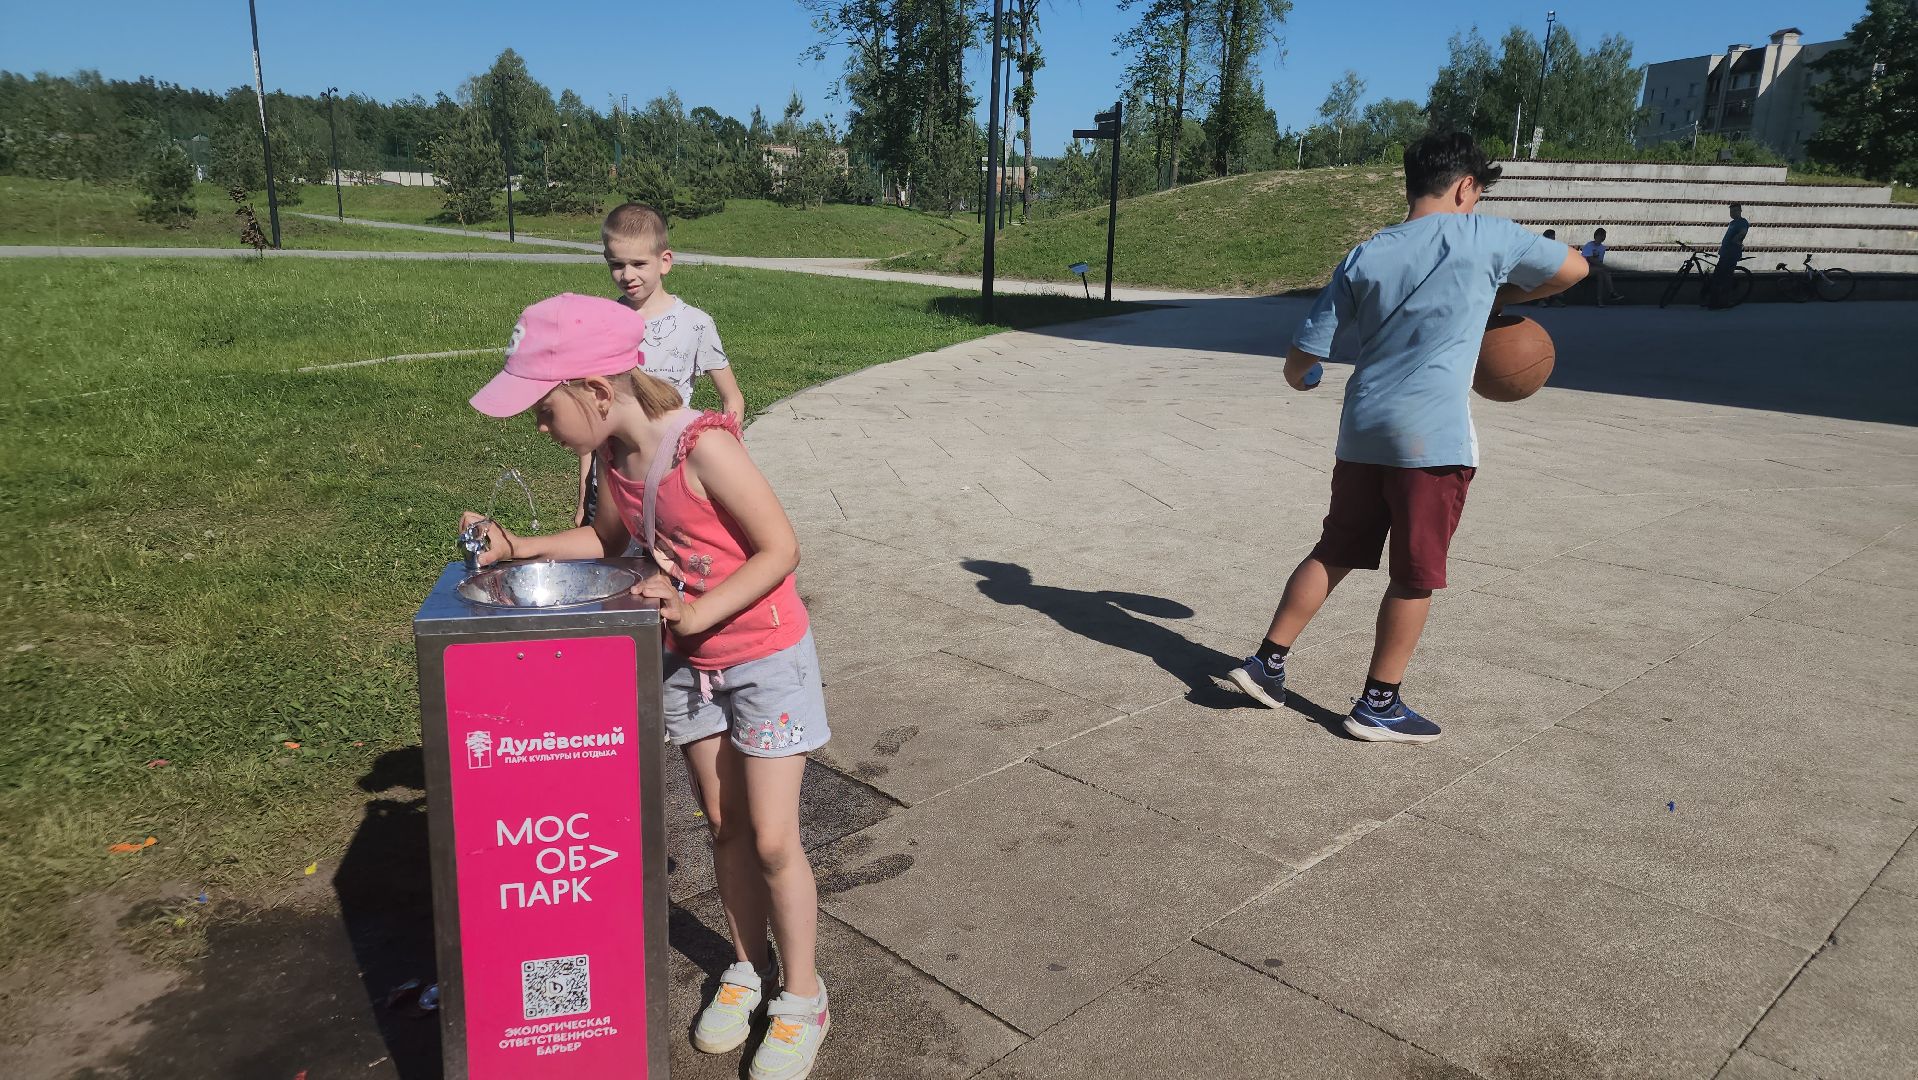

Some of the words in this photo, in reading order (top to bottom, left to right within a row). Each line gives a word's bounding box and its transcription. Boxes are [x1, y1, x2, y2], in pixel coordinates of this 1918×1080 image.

[497, 727, 625, 756] Дулёвский
[504, 755, 528, 764] ПАРК
[529, 751, 572, 763] КУЛЬТУРЫ
[573, 751, 581, 759] И
[582, 749, 617, 759] ОТДЫХА
[496, 813, 590, 846] МОС
[500, 876, 592, 910] ПАРК
[499, 1026, 618, 1049] ОТВЕТСТВЕННОСТЬ
[504, 1016, 611, 1037] ЭКОЛОГИЧЕСКАЯ
[536, 1041, 582, 1056] БАРЬЕР
